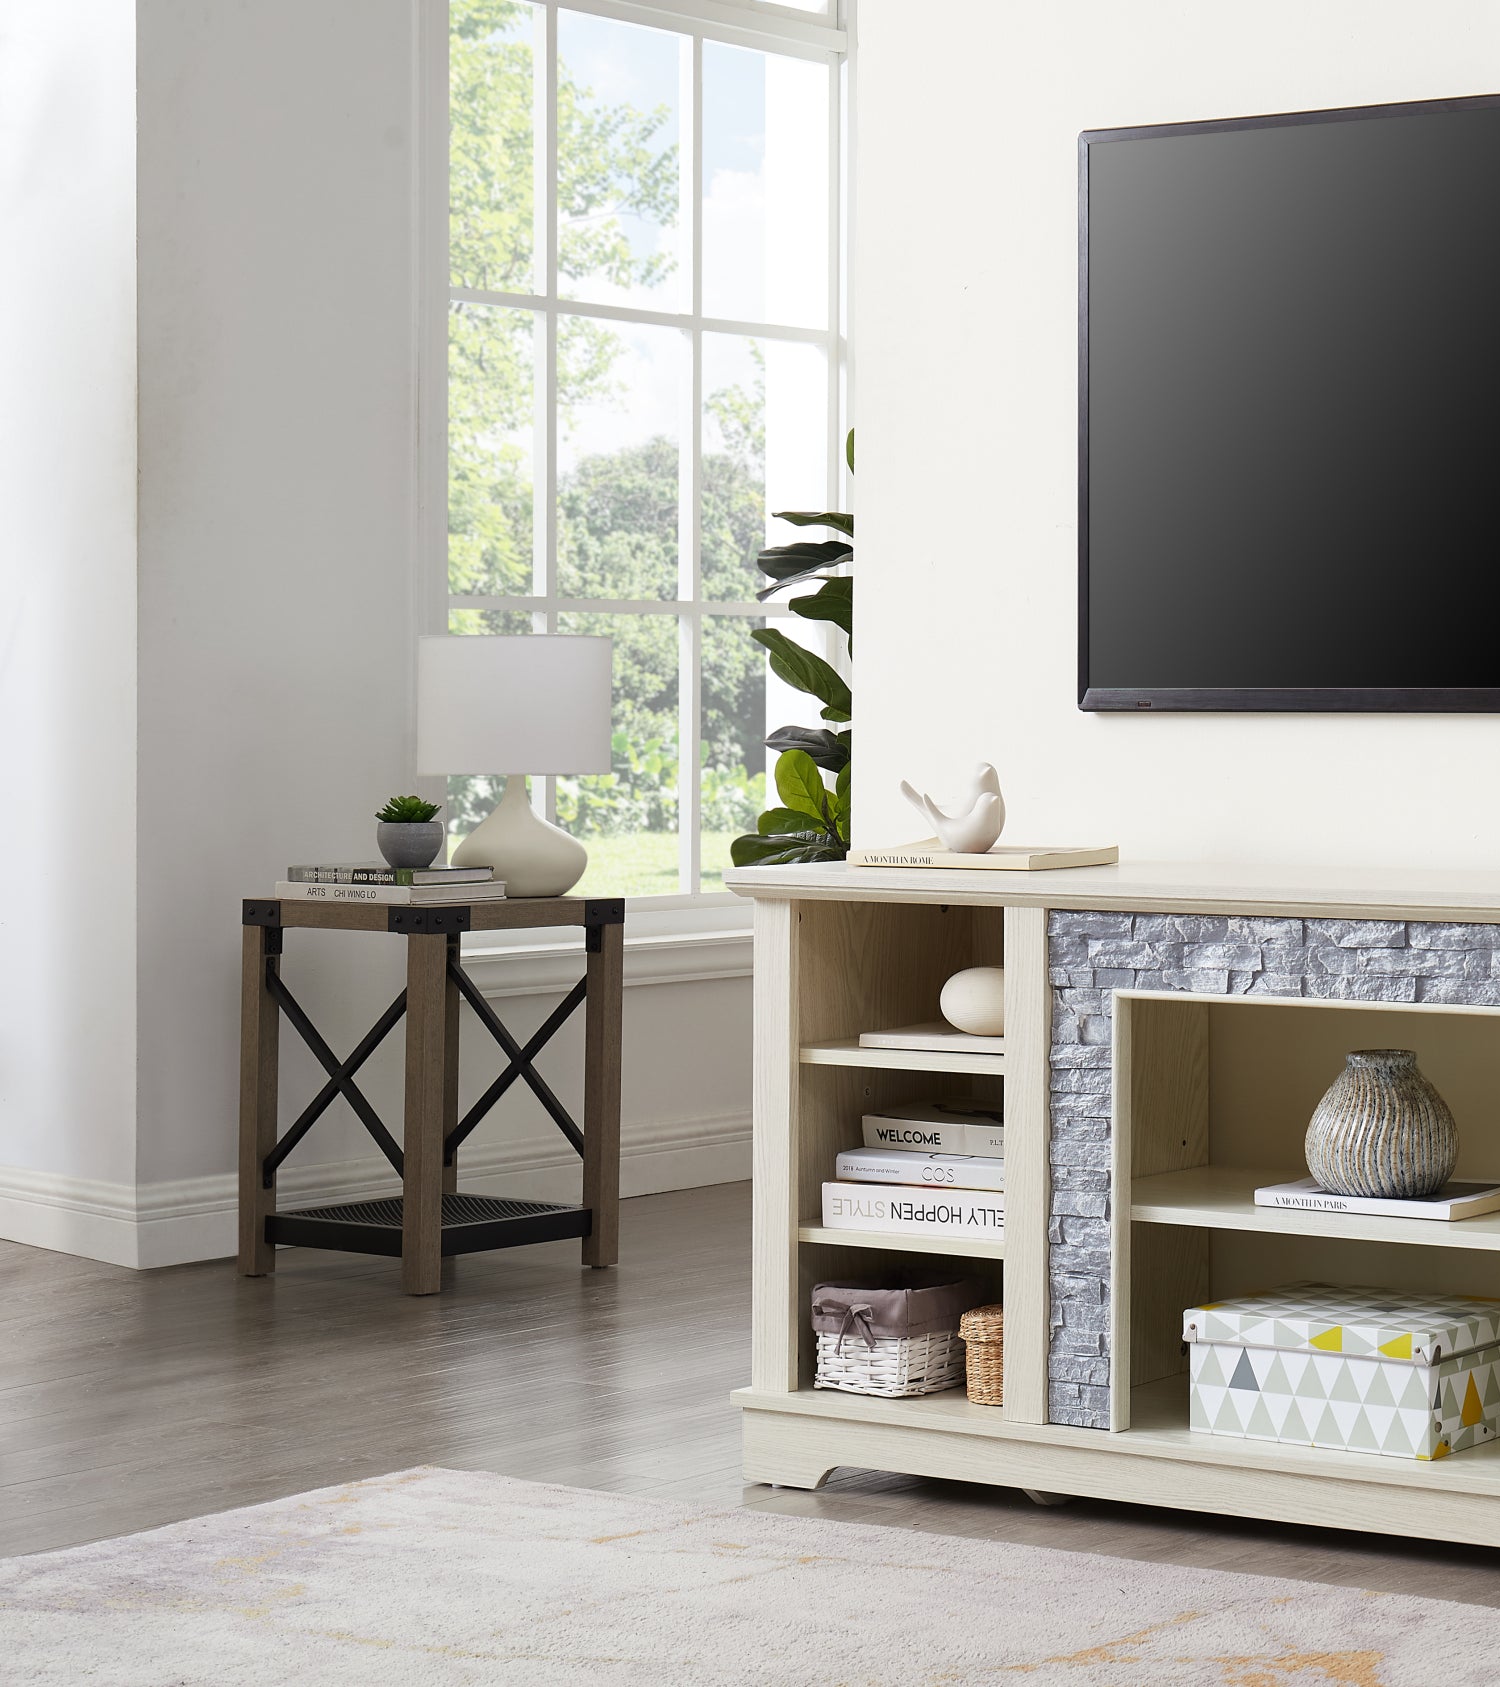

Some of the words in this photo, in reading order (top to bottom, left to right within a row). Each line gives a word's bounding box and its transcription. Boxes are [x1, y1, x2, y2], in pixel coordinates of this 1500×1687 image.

[863, 855, 869, 864] A
[870, 855, 899, 864] MONTH
[900, 856, 909, 864] IN
[910, 856, 934, 865] ROME
[304, 871, 352, 880] ARCHITECTURE
[353, 872, 369, 881] AND
[369, 873, 394, 882] DESIGN
[307, 887, 326, 897] ARTS
[334, 889, 346, 898] CHI
[347, 890, 366, 899] WING
[366, 891, 377, 899] LO
[876, 1128, 942, 1146] WELCOME
[921, 1166, 955, 1183] COS
[832, 1197, 885, 1219] STYLE
[1275, 1196, 1280, 1205] A
[1281, 1197, 1312, 1207] MONTH
[1313, 1199, 1322, 1207] IN
[1324, 1200, 1348, 1210] PARIS
[890, 1201, 962, 1225] HOPPEN
